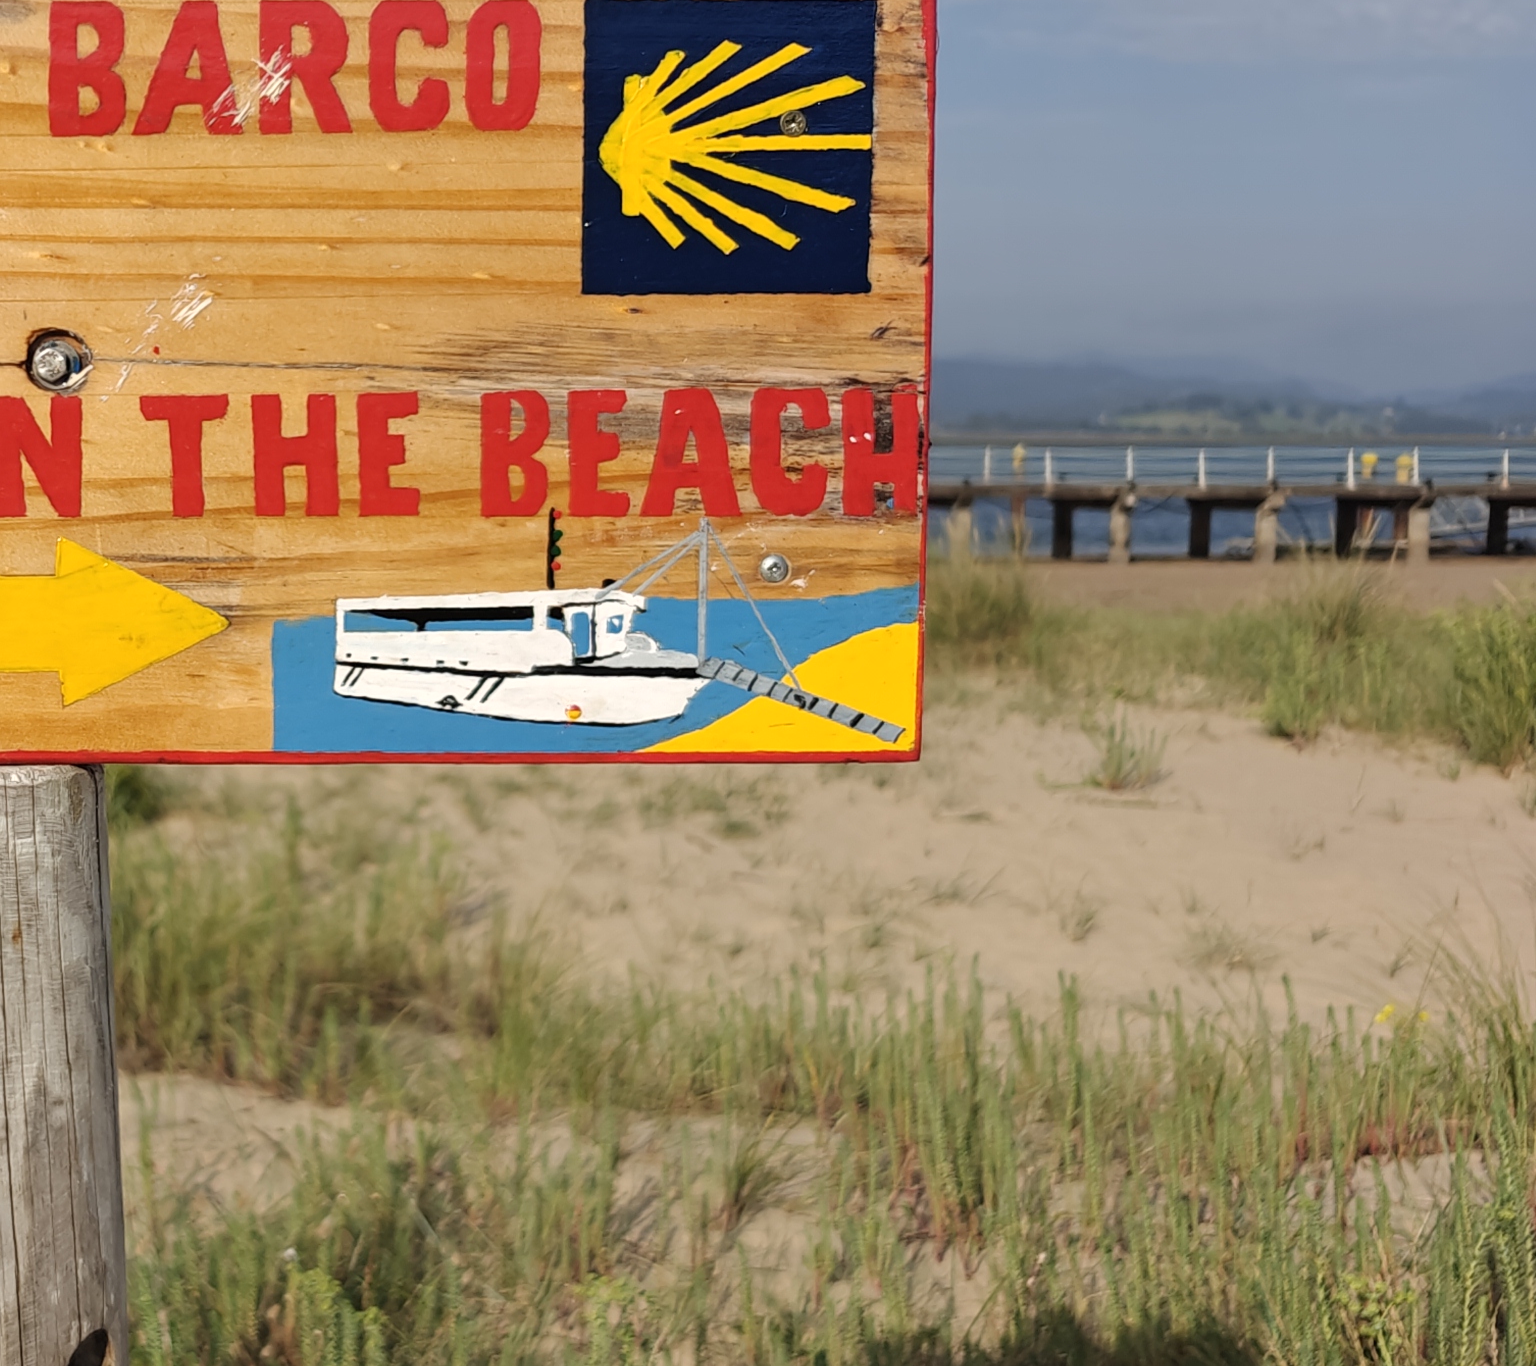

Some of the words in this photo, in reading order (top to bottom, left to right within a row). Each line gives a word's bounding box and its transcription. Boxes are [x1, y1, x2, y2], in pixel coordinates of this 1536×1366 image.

[48, 0, 542, 137] BARCO
[140, 392, 421, 519] THE
[480, 386, 920, 519] BEACH
